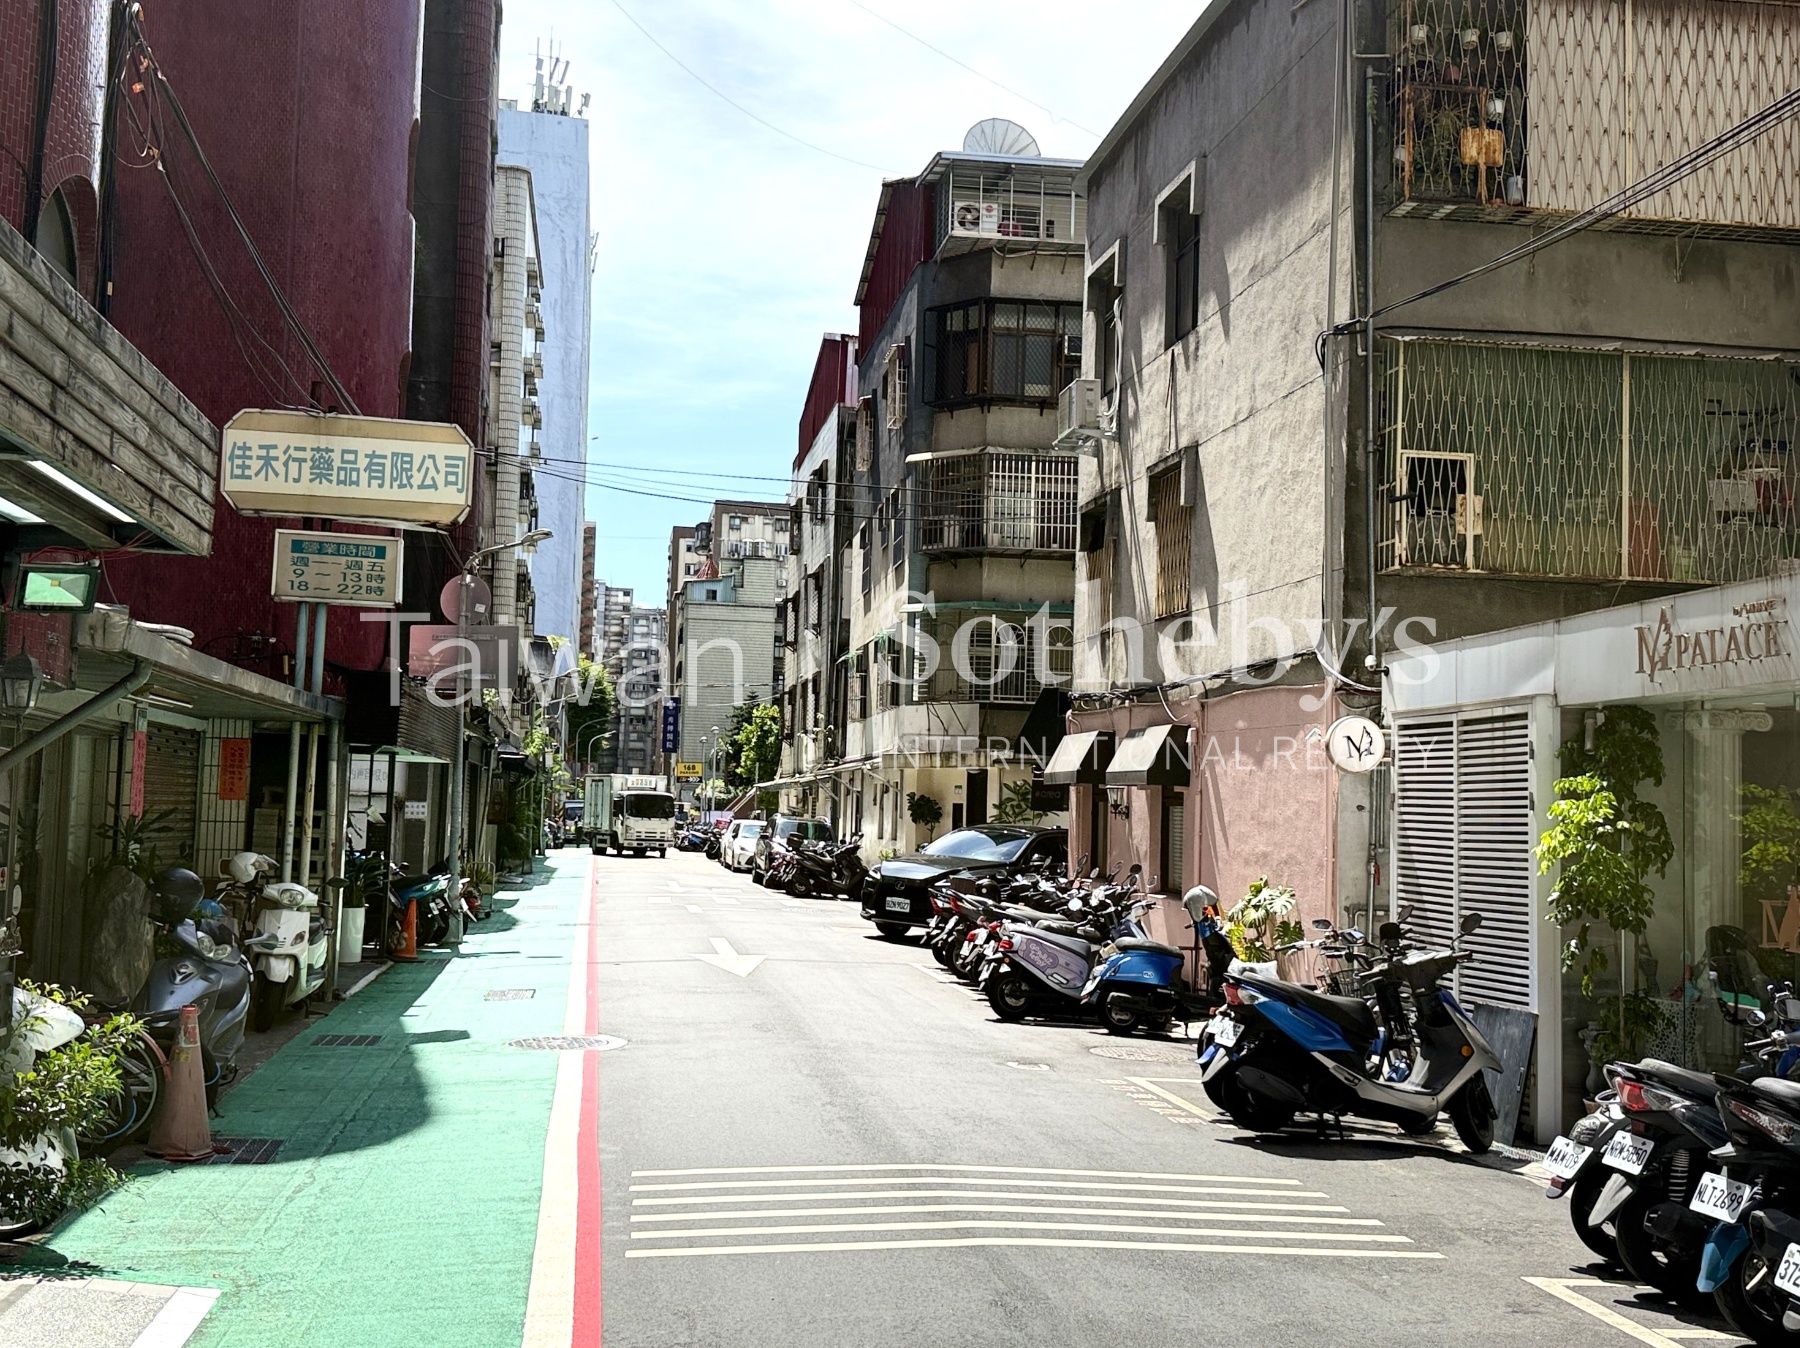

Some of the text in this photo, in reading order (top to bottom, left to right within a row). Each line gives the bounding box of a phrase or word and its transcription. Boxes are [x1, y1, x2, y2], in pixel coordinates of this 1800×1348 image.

[227, 441, 467, 494] 佳禾行藥品有限公司
[301, 541, 377, 558] 營業時間
